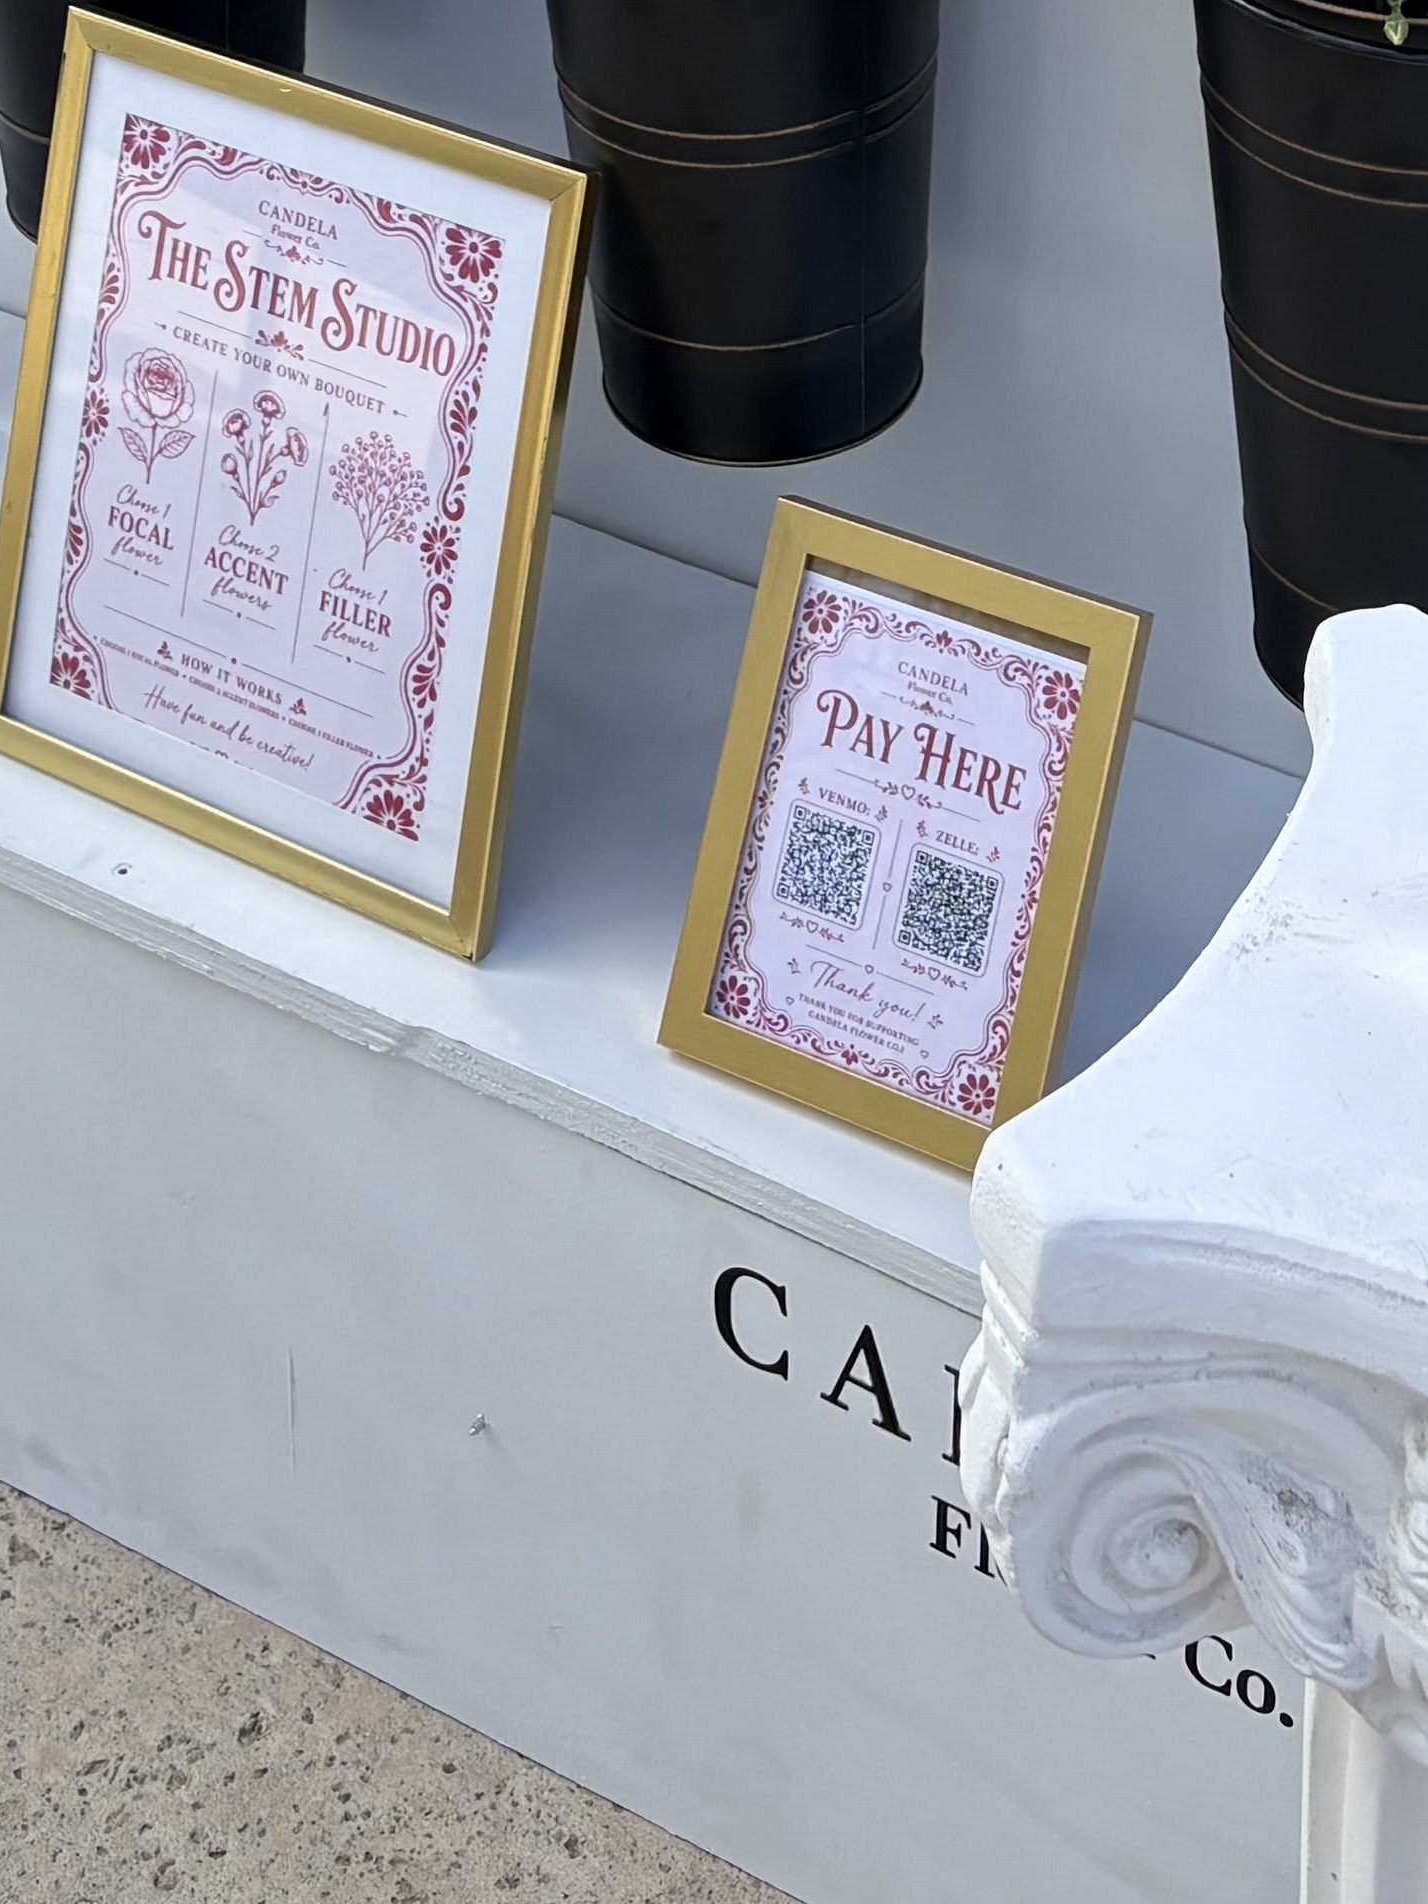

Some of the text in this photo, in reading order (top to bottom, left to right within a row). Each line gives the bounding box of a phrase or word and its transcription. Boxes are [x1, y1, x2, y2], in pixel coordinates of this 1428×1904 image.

[258, 200, 338, 240] CANDELA
[271, 224, 303, 244] Flower
[172, 325, 386, 415] CREATE YOUR OWN BOUQUET
[116, 483, 172, 520] Choose 1
[107, 505, 174, 551] FOCAL
[218, 524, 281, 563] Choose 2
[110, 536, 164, 566] flower
[203, 545, 289, 596] ACCENT
[210, 576, 273, 611] flowers
[328, 568, 388, 606] Choose 1
[318, 589, 392, 638] FILLER
[321, 620, 381, 654] flower
[181, 653, 283, 706] HOW IT WORKS
[897, 661, 969, 697] CANDELA
[144, 684, 315, 773] Have fun and be creative!
[816, 689, 1027, 815] PAY HERE
[819, 787, 871, 817] VENMO:
[935, 830, 979, 856] ZELLE:
[810, 960, 927, 1022] Thank you!
[808, 1010, 848, 1033] CANDELA
[849, 1025, 885, 1048] FLOWER
[713, 1266, 963, 1468] CA
[1184, 1634, 1295, 1729] Co.
